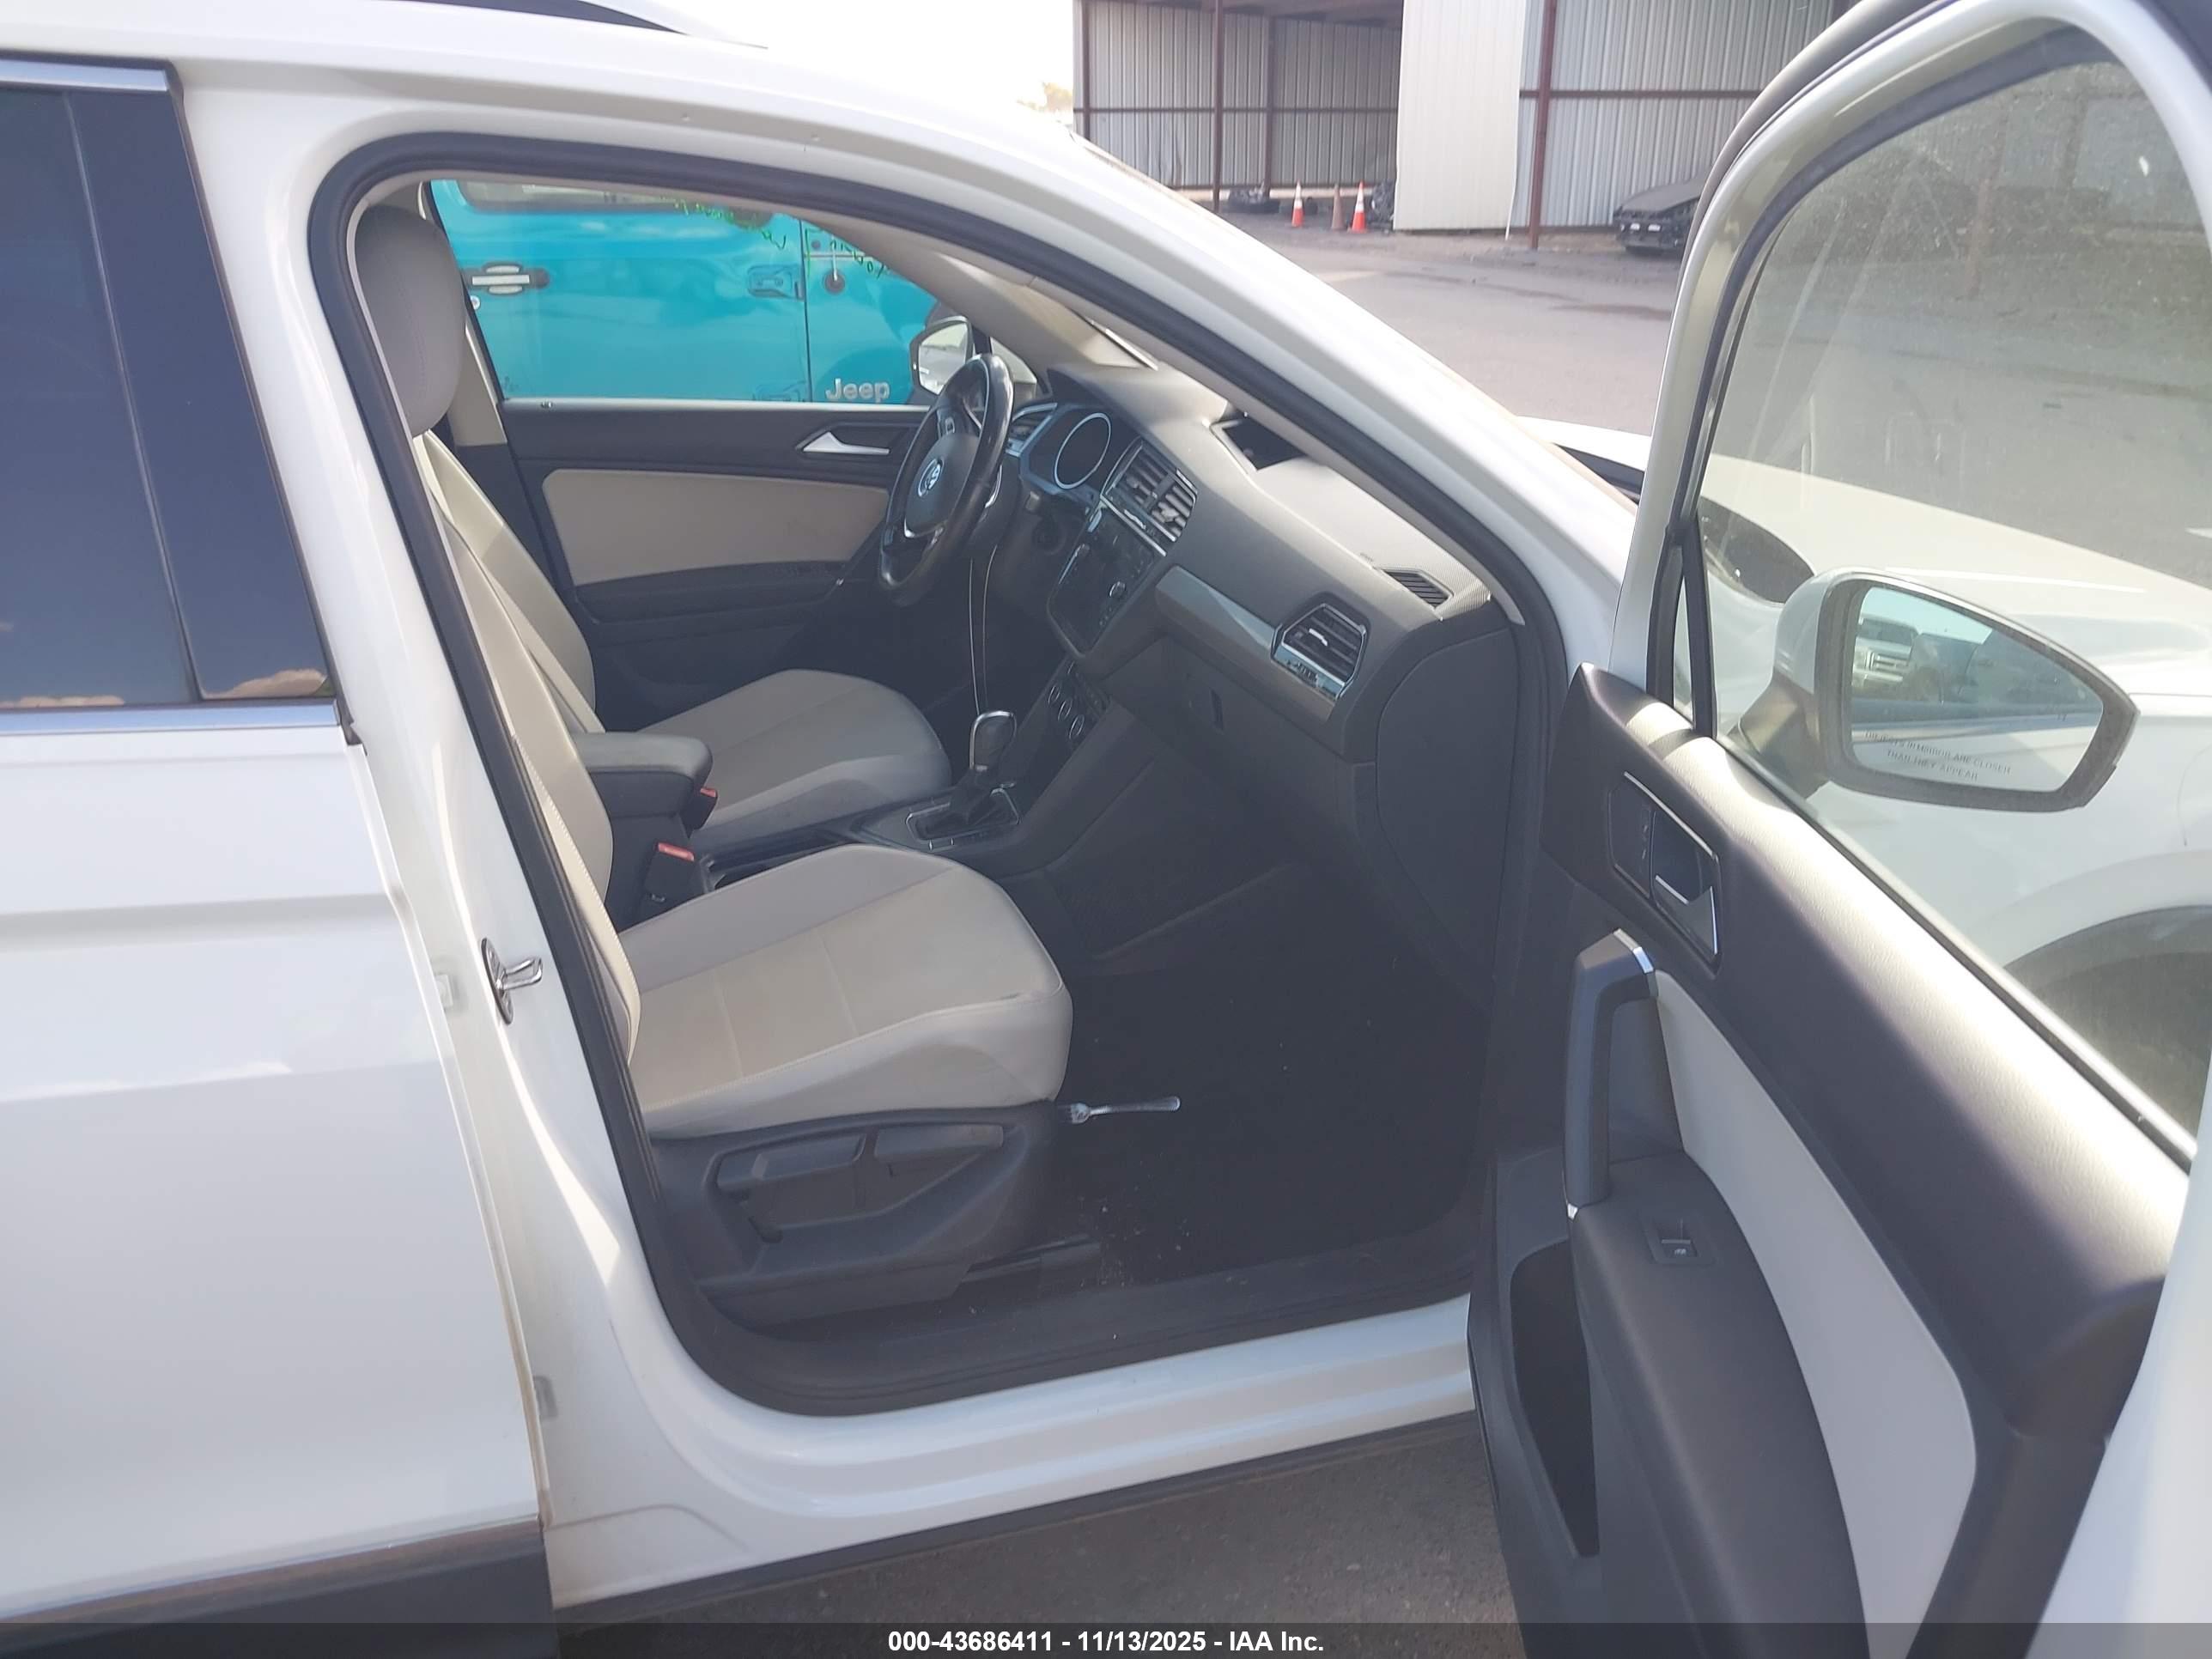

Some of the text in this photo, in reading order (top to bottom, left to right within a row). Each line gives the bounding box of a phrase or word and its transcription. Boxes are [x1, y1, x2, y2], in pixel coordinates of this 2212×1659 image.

[825, 378, 890, 403] Jeep
[1887, 749, 1911, 763] THAN
[1939, 763, 1978, 781] APPEAR
[1954, 752, 1972, 763] ARE
[1973, 757, 2011, 775] CLOSER
